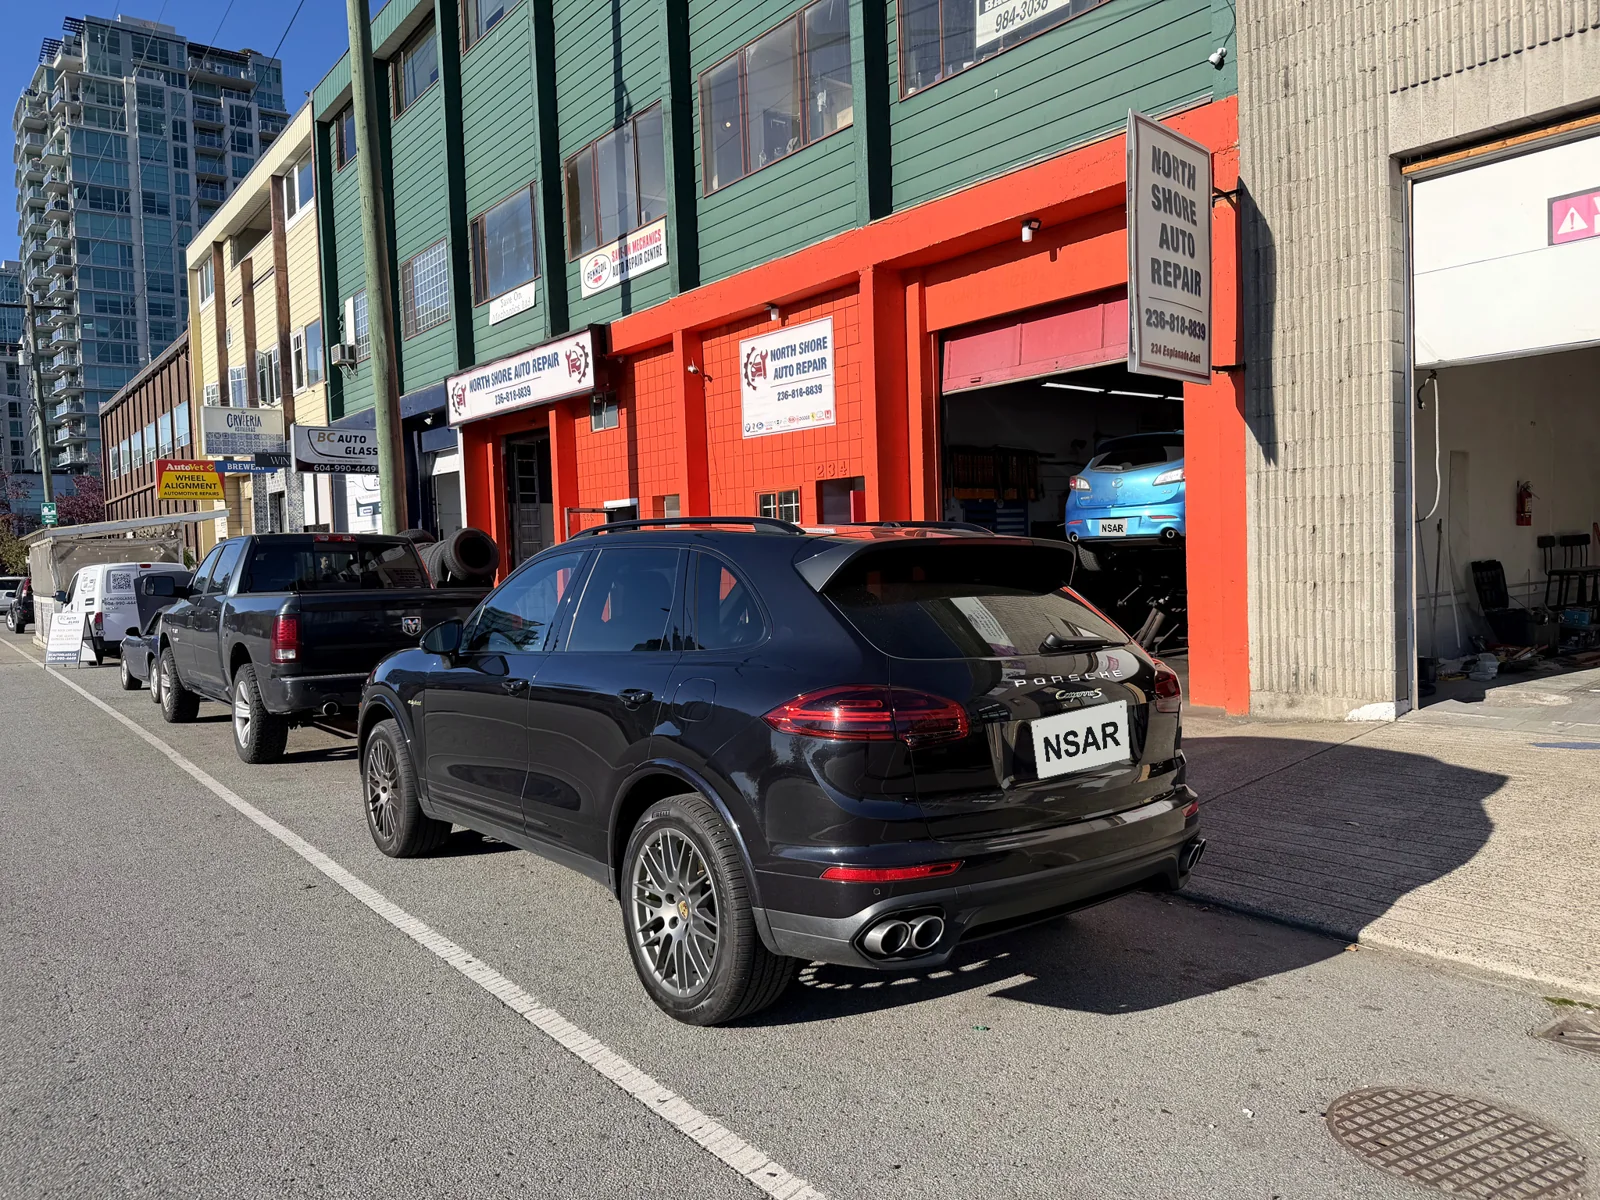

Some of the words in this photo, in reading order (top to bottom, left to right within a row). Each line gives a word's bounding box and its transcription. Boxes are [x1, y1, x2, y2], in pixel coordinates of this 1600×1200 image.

[1151, 144, 1196, 192] NORTH
[1151, 183, 1197, 227] SHORE
[632, 228, 661, 253] MECHANICS
[1158, 223, 1196, 259] AUTO
[612, 261, 624, 277] AUTO
[625, 253, 643, 272] REPAIR
[644, 243, 662, 263] CENTRE
[1150, 257, 1201, 298] REPAIR
[1145, 308, 1206, 341] 236-818-8839
[770, 343, 797, 362] NORTH
[799, 336, 828, 355] SHORE
[1150, 342, 1162, 355] 234
[1162, 345, 1189, 361] Esplanade
[1189, 351, 1201, 364] East
[469, 374, 491, 393] NORTH
[491, 367, 513, 386] SHORE
[514, 361, 531, 380] AUTO
[532, 351, 560, 373] REPAIR
[773, 363, 794, 381] AUTO
[796, 356, 828, 376] REPAIR
[777, 383, 823, 402] 236-818-8839
[317, 432, 336, 442] BC
[337, 435, 367, 443] AUTO
[345, 446, 378, 456] GLASS
[166, 463, 204, 471] AutoVet
[313, 464, 377, 473] 604-990-4449
[816, 461, 848, 478] 234
[1102, 524, 1124, 533] NSAR
[1014, 669, 1124, 688] PORSCHE
[1043, 721, 1122, 763] NSAR
